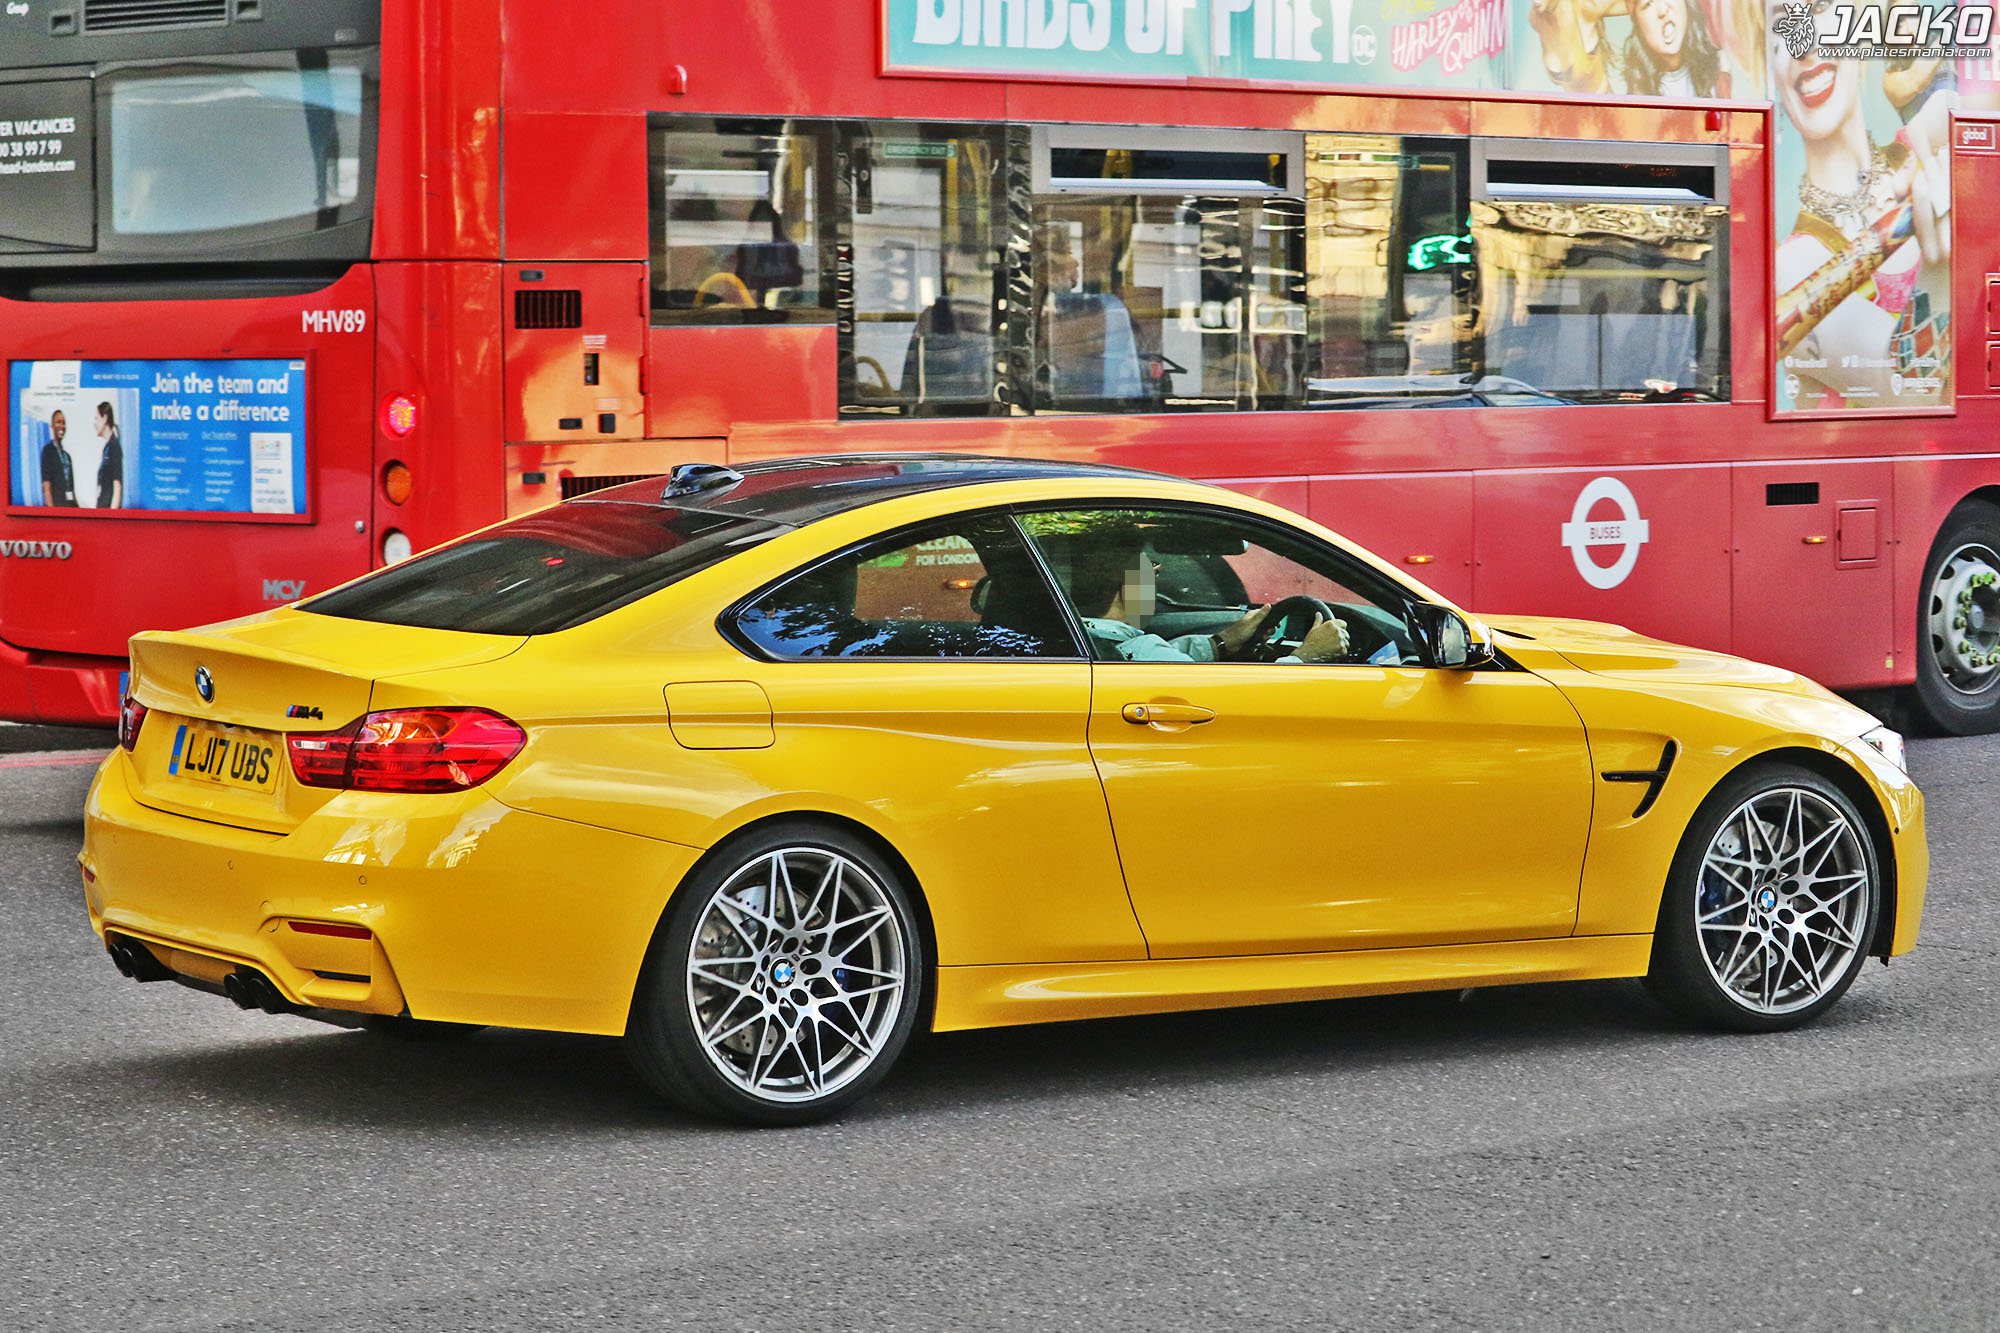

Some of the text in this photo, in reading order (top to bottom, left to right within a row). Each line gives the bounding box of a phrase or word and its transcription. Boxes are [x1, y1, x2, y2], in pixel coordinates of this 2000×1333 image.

[1351, 34, 1376, 58] DC
[1392, 10, 1458, 70] HARLEY
[1443, 0, 1507, 72] QUINN
[14, 117, 76, 135] VACANCIES
[1961, 129, 1988, 145] global
[10, 141, 23, 156] 38
[24, 141, 38, 156] 99
[39, 140, 47, 155] 7
[47, 140, 62, 154] 99
[302, 309, 366, 333] MHV89
[151, 372, 290, 394] Join the team and
[151, 400, 290, 422] make a difference
[1590, 526, 1621, 540] BUSES
[0, 539, 73, 560] VOLVO
[916, 554, 936, 566] FOR
[263, 579, 307, 601] MCV
[290, 704, 323, 720] M4
[184, 733, 274, 784] LJ17 UBS
